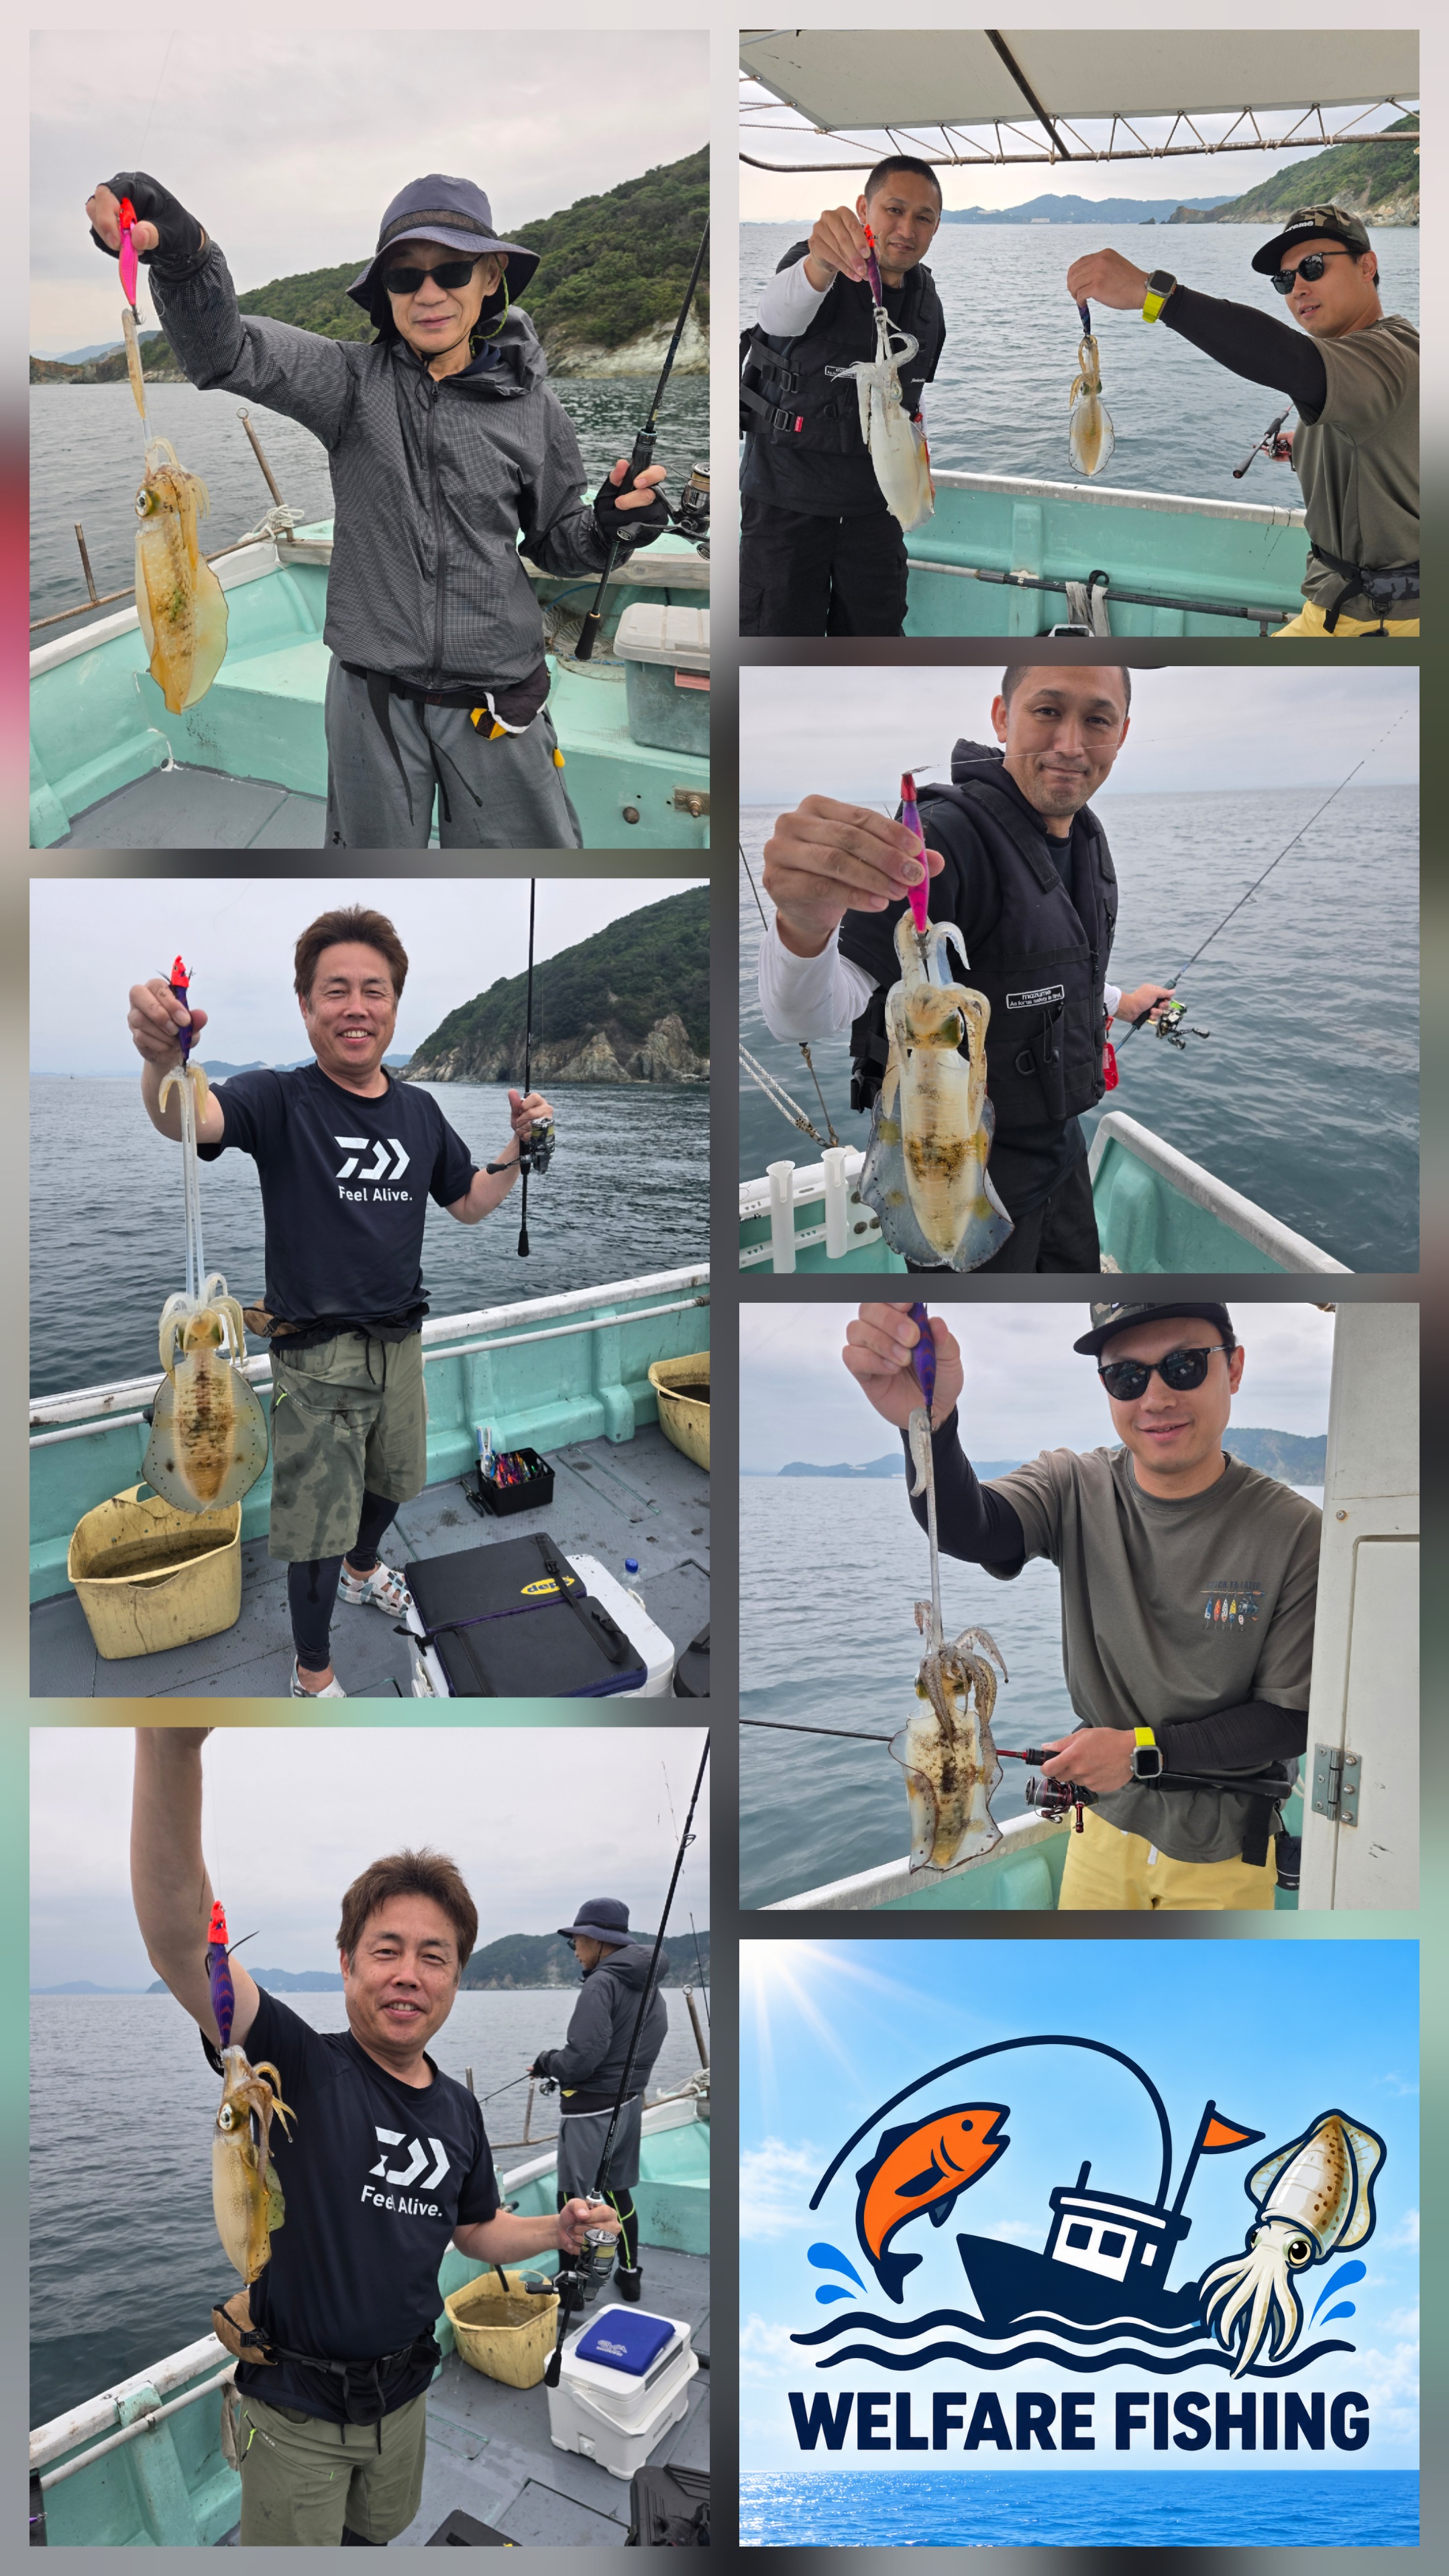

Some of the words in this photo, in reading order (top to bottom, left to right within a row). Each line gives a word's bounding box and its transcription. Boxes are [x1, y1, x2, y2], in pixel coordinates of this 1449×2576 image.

[1284, 221, 1314, 233] reme
[1022, 989, 1052, 1000] mazume
[338, 1185, 368, 1201] Feel
[372, 1188, 413, 1201] Alive.
[361, 2185, 396, 2212] Feel
[398, 2197, 443, 2217] Alive.
